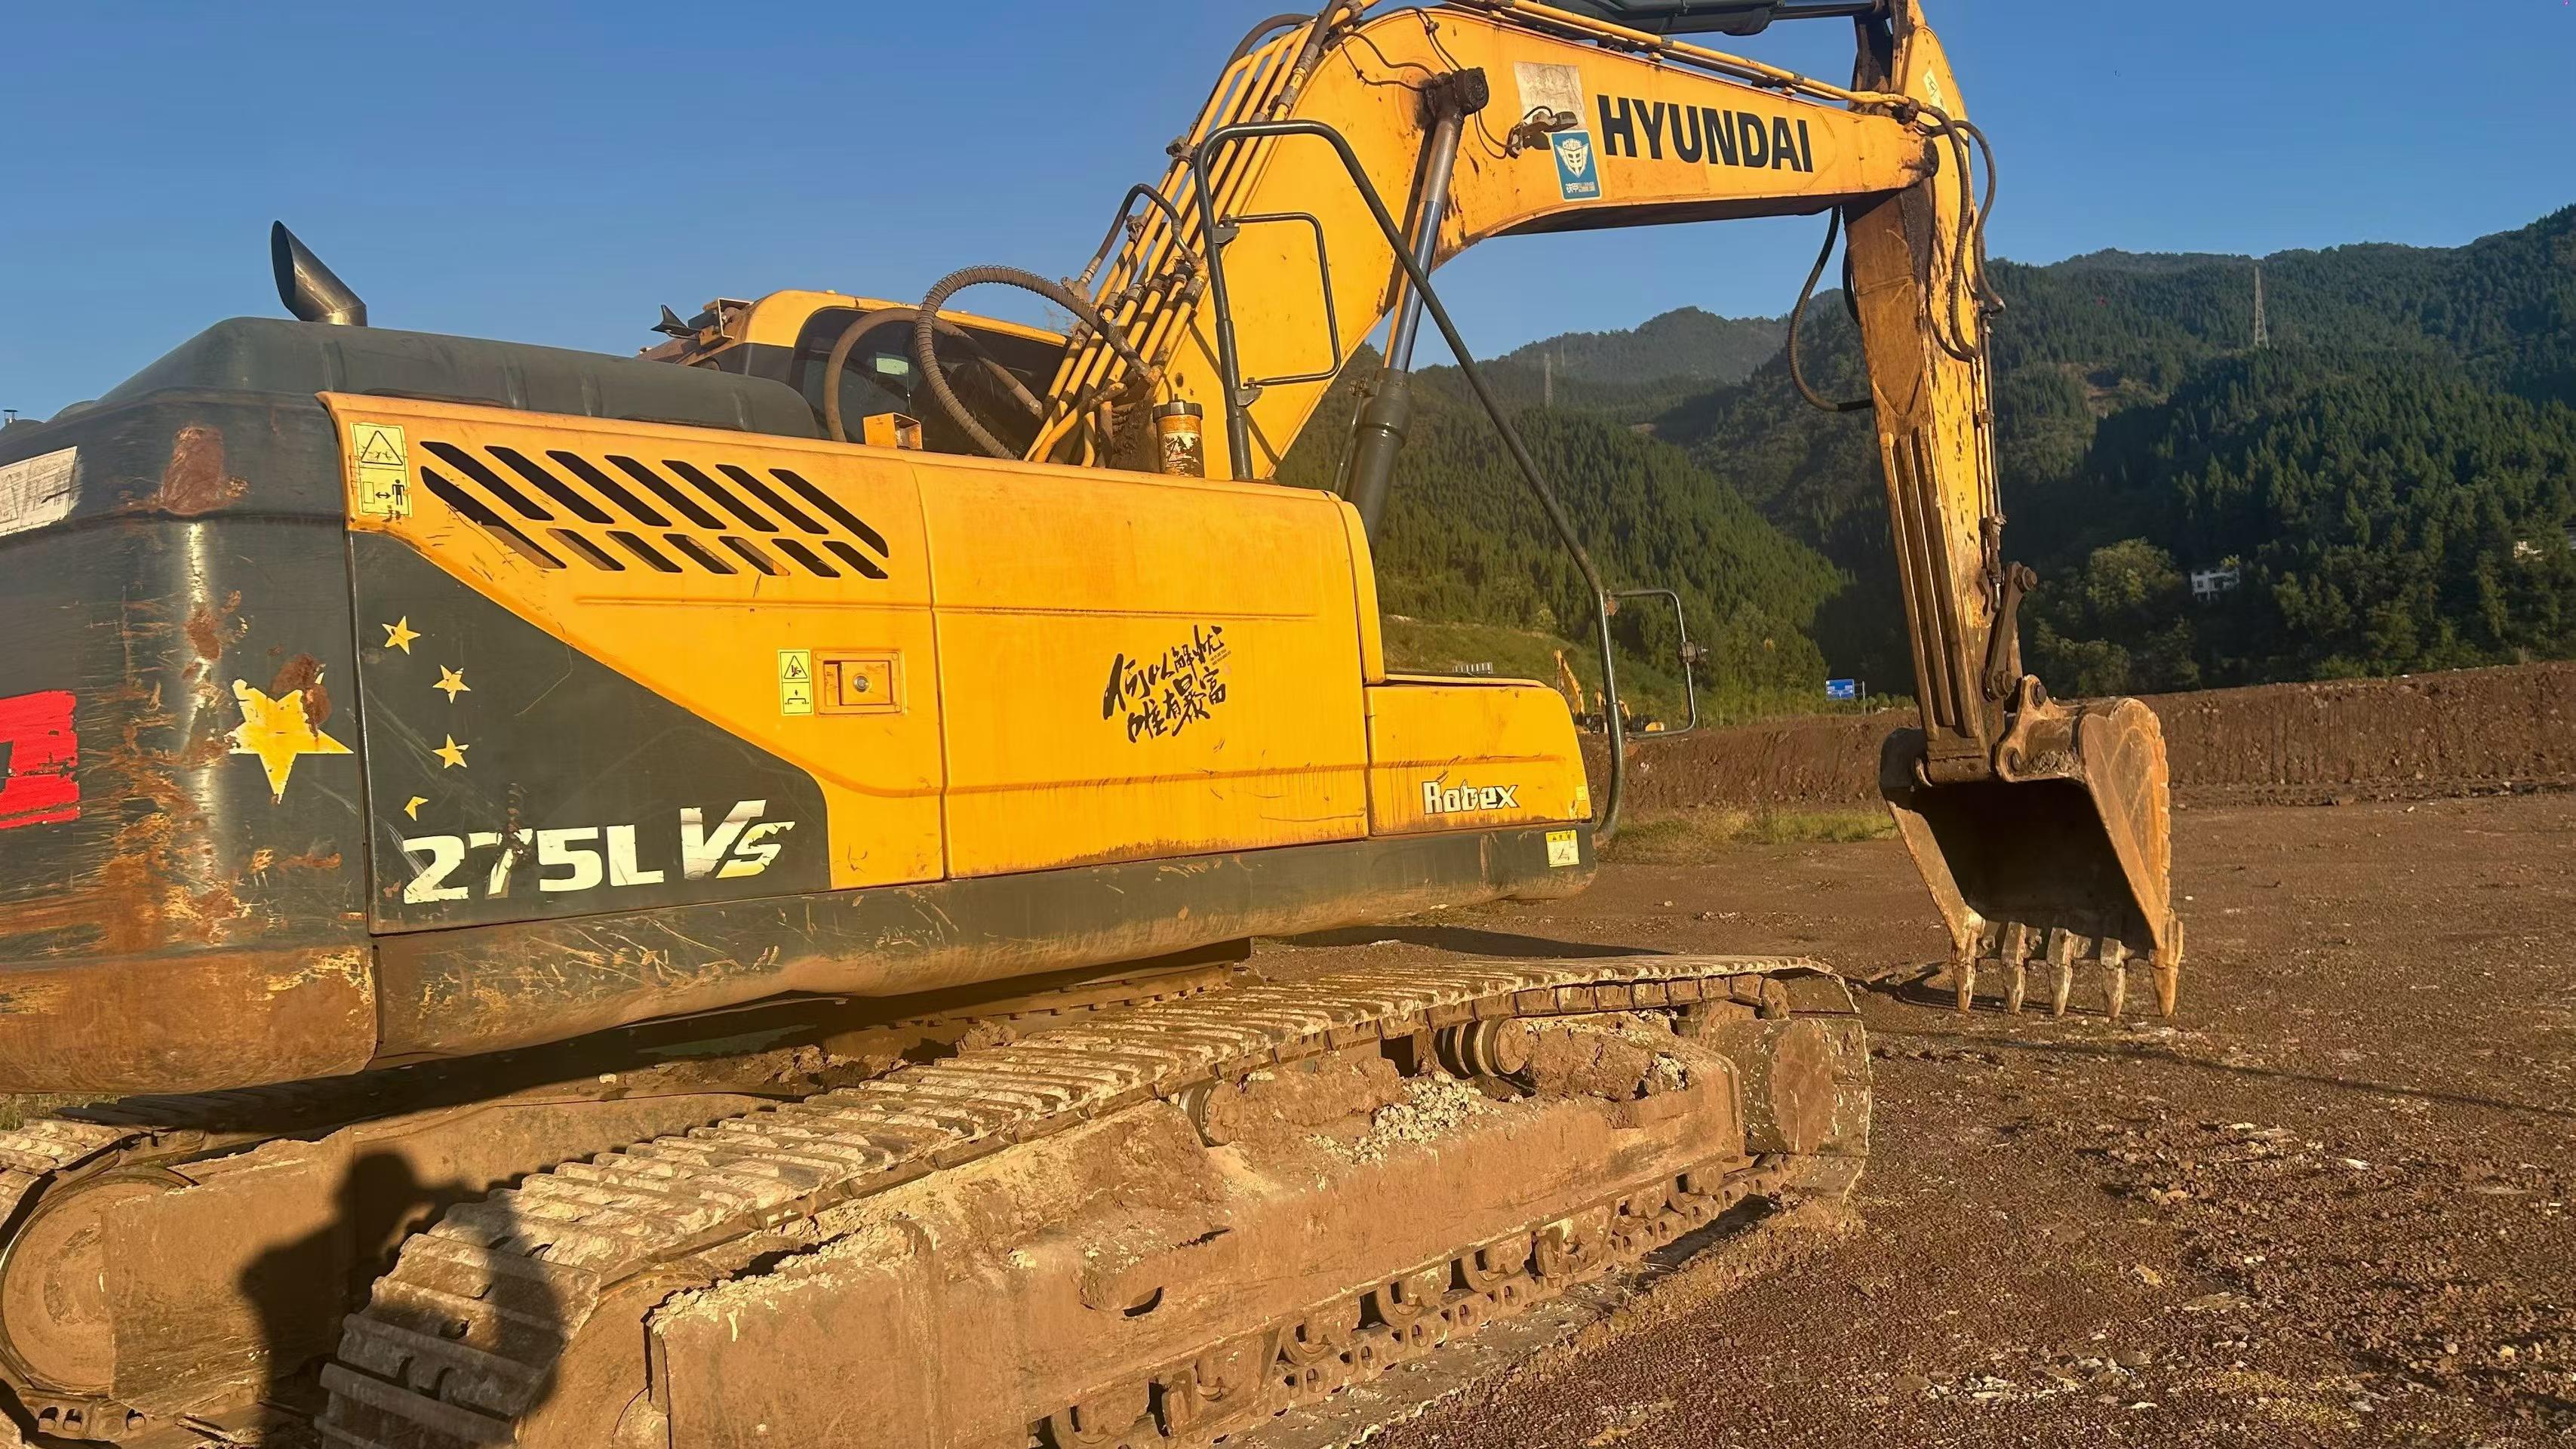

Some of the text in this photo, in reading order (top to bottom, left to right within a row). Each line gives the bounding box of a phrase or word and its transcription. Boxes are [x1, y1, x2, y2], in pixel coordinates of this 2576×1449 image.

[1597, 94, 1813, 173] HYUNDAI
[1102, 624, 1225, 721] 何以解忧
[1422, 779, 1520, 815] Robex
[403, 824, 664, 904] 275L
